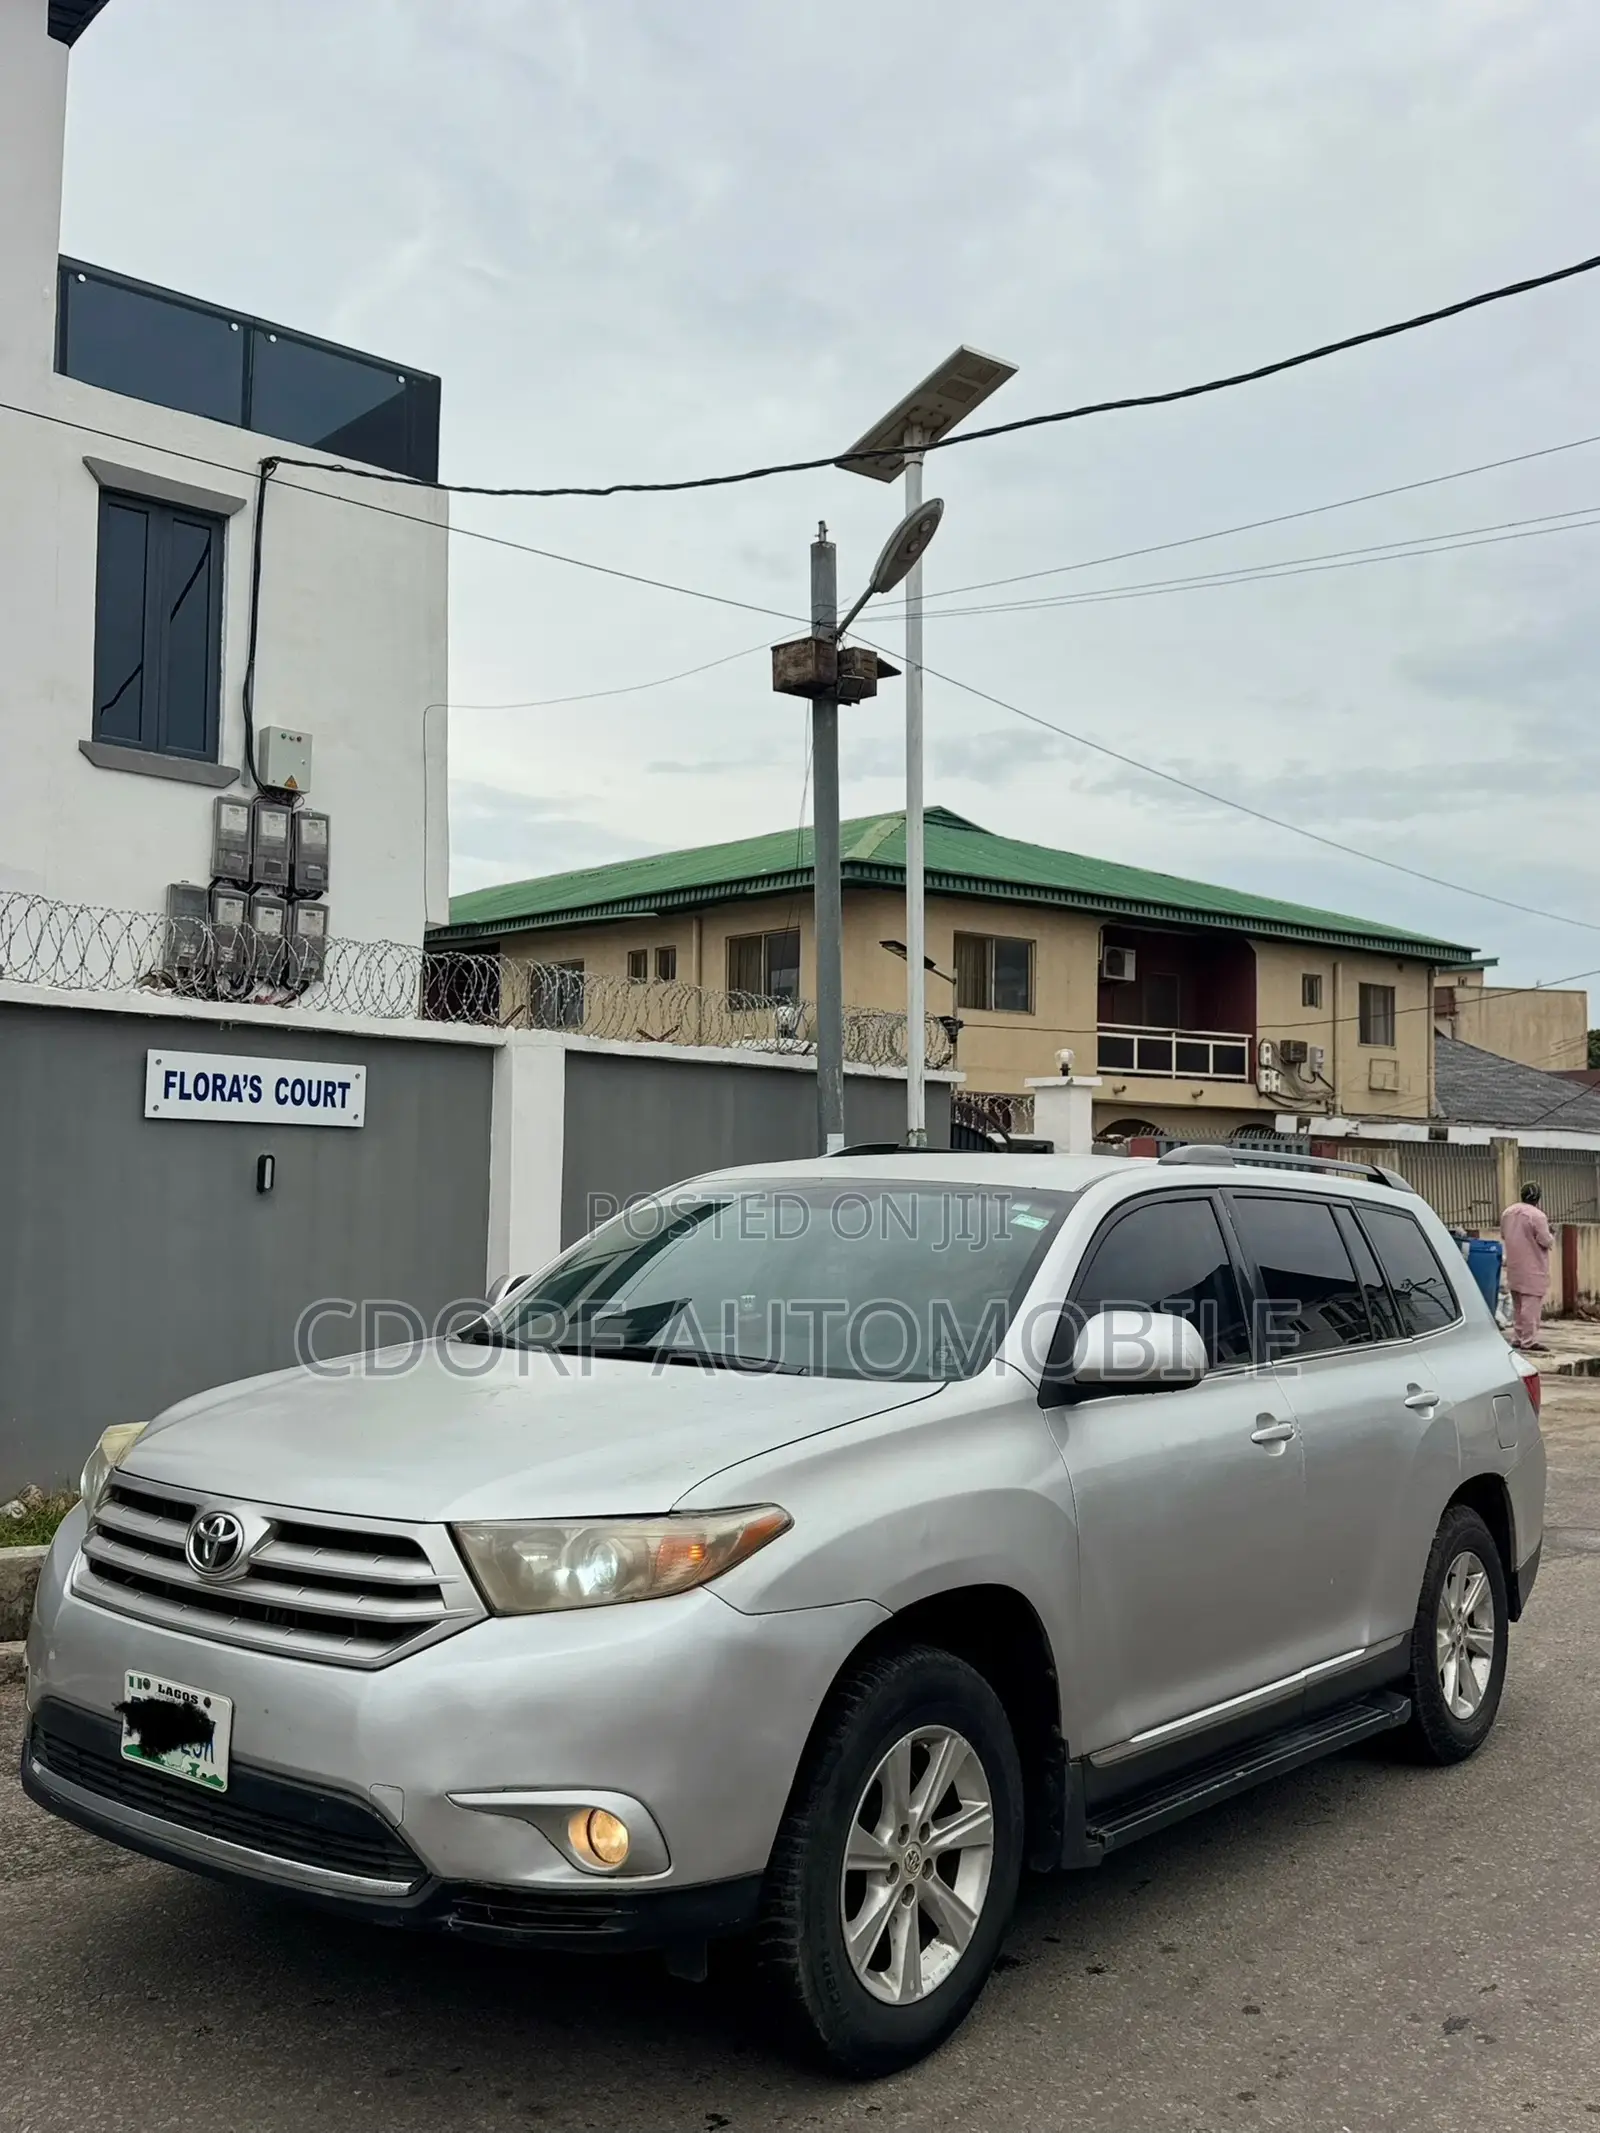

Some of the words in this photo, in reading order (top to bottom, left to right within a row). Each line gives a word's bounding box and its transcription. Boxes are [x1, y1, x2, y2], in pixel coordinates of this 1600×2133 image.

[163, 1070, 262, 1104] FLORA'S
[274, 1077, 351, 1108] COURT
[158, 1684, 199, 1705] LAGOS
